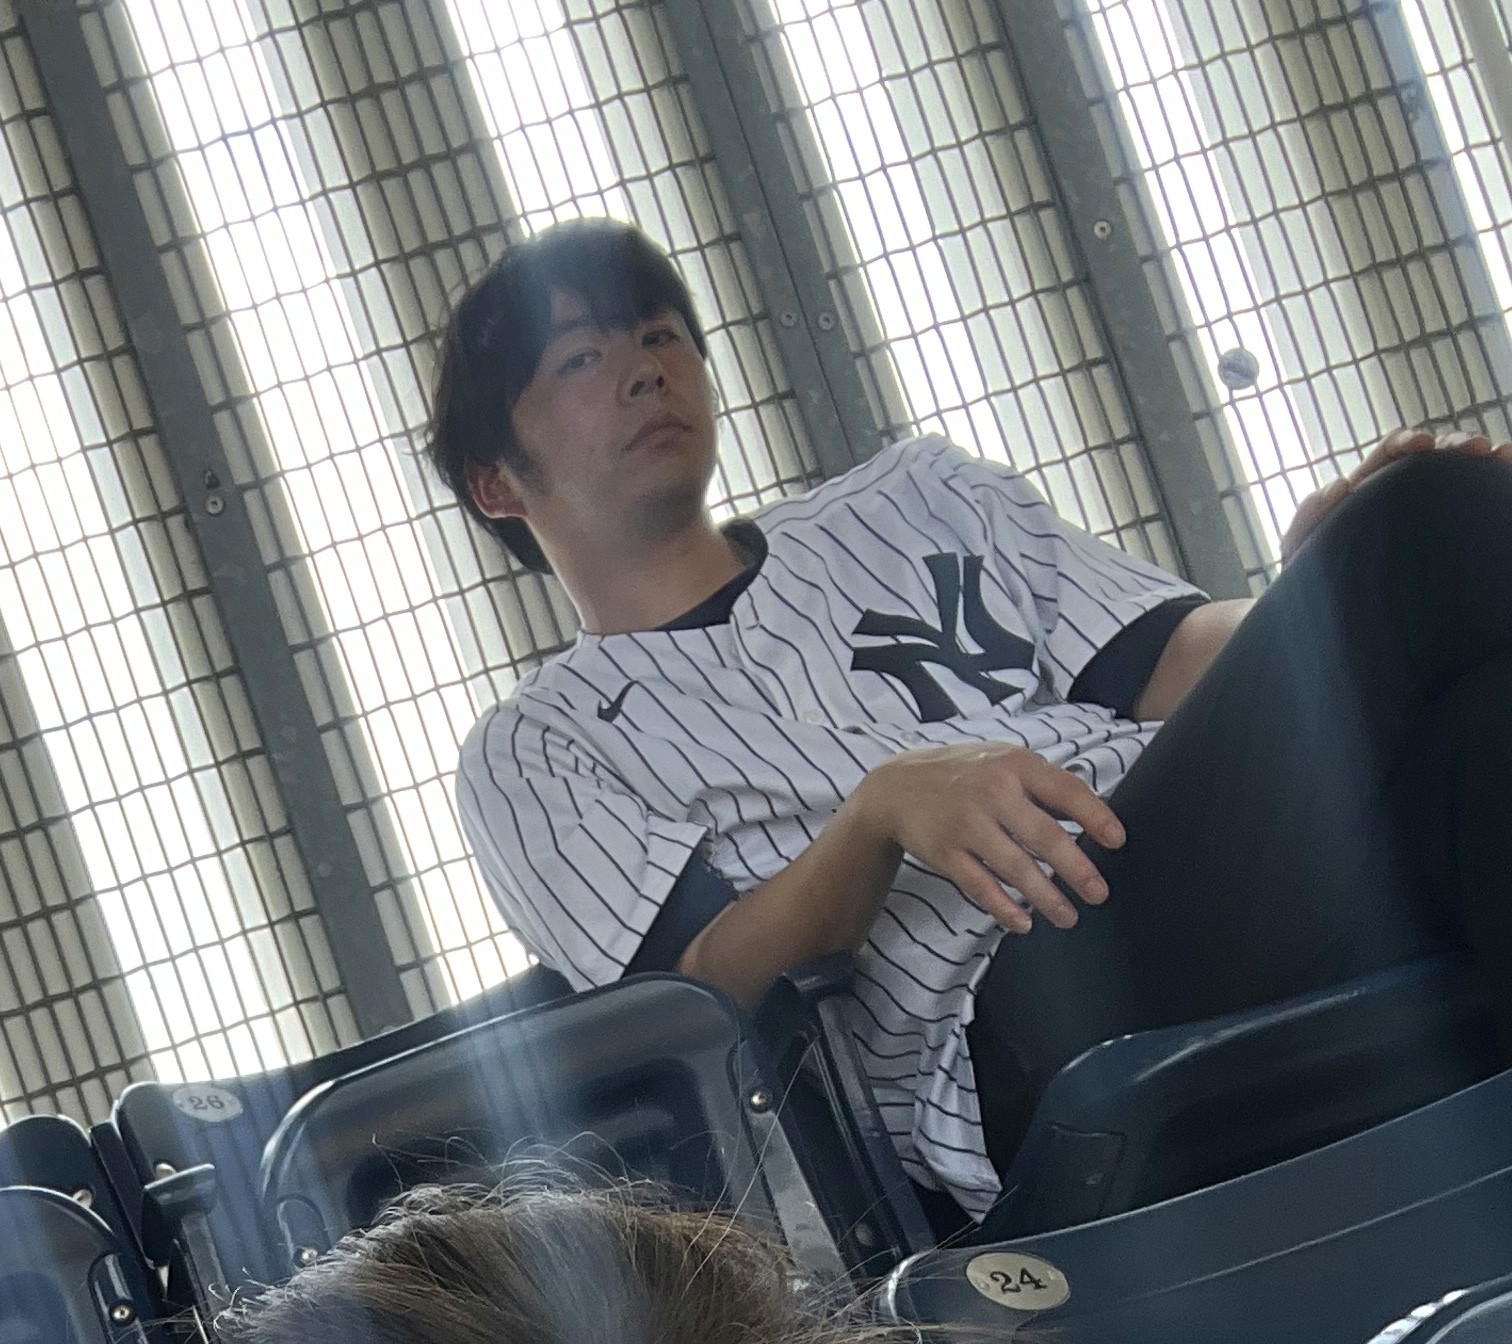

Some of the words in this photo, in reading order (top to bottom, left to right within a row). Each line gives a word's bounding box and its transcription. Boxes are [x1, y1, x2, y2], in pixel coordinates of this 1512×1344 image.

[850, 552, 1037, 723] NY
[188, 1094, 225, 1111] 26
[990, 1267, 1047, 1295] 24
